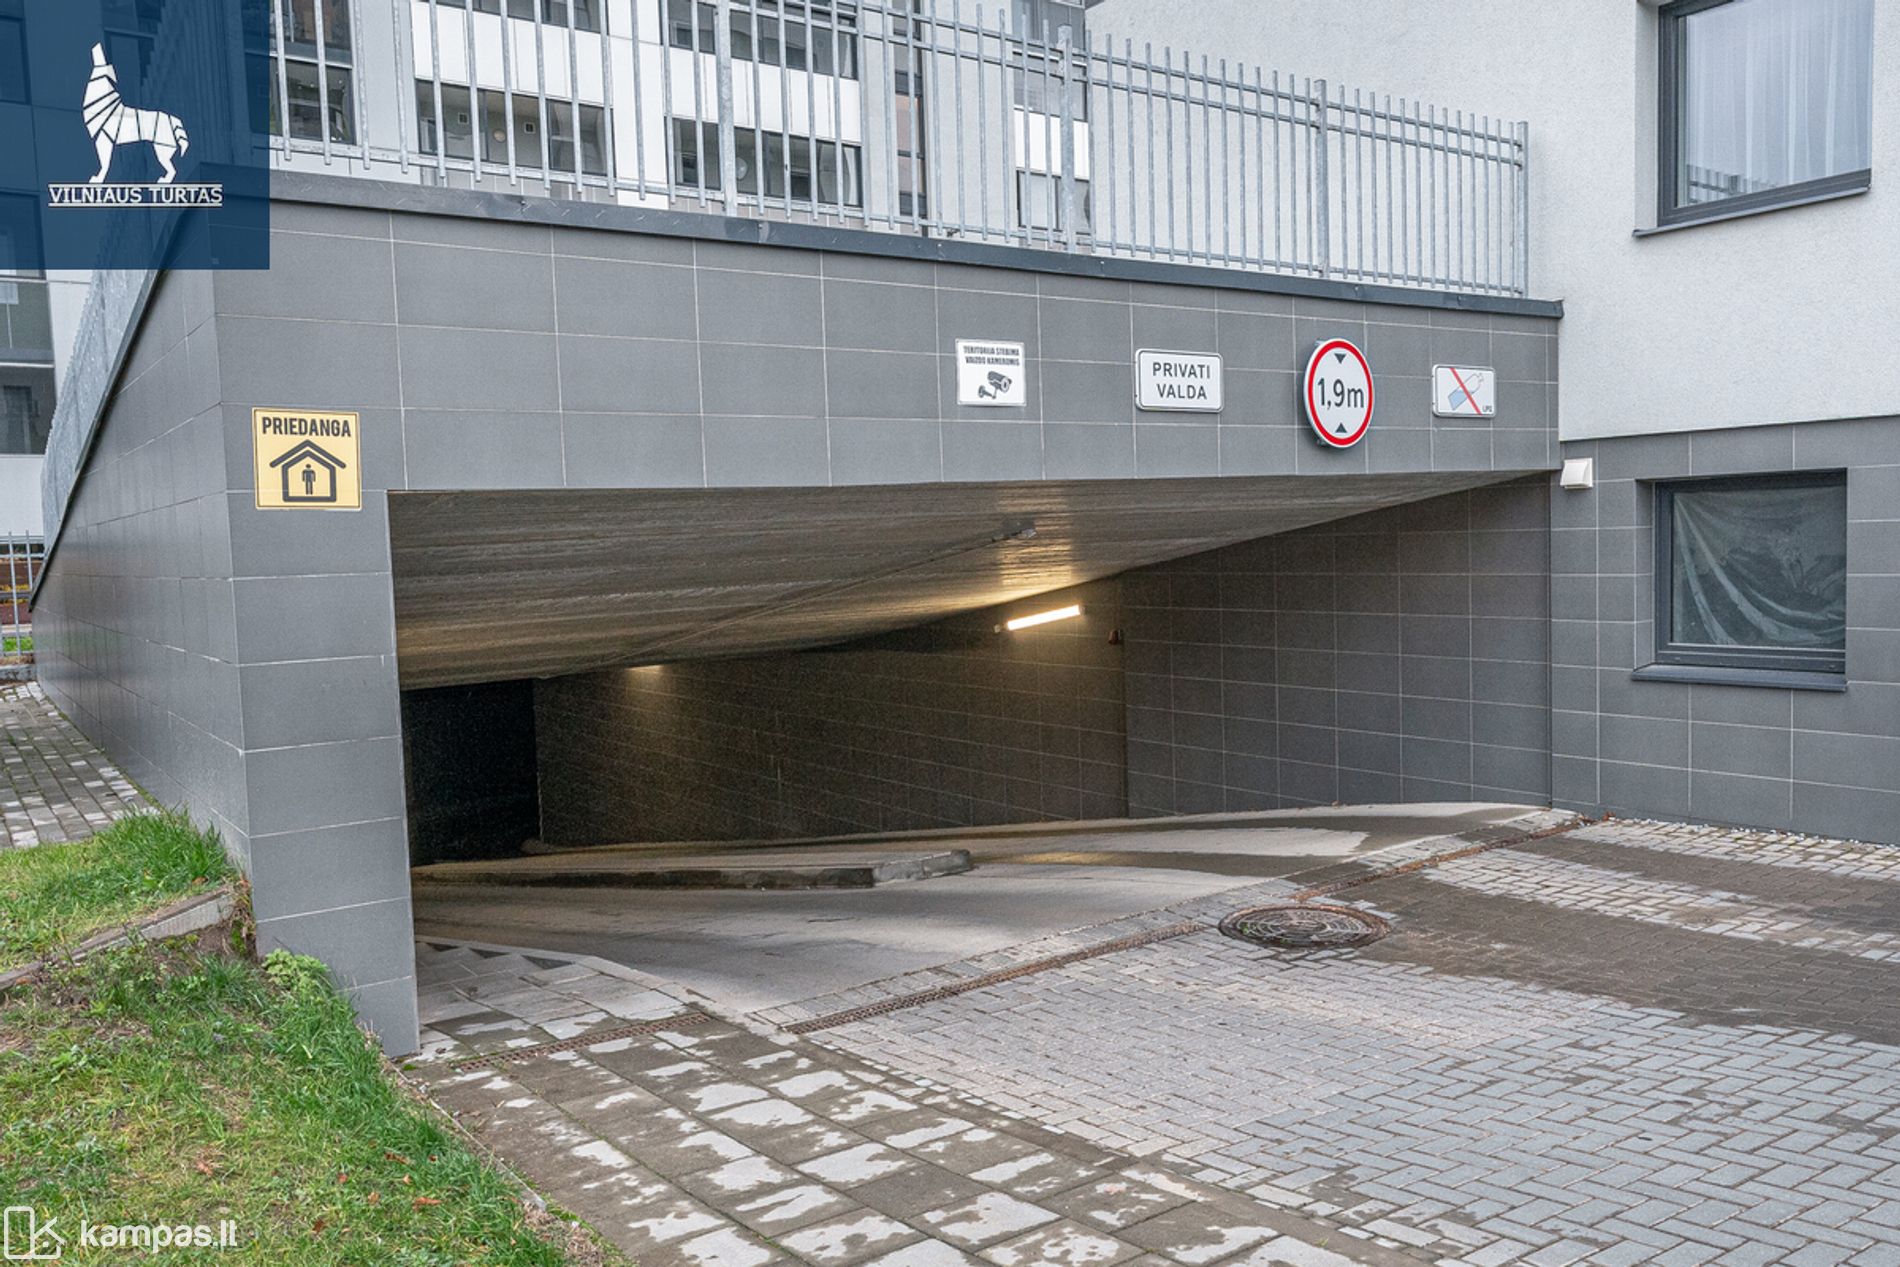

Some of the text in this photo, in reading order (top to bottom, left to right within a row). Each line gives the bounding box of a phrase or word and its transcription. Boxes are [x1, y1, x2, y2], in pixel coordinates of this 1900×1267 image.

[1152, 362, 1211, 379] PRIVATI
[1156, 383, 1207, 400] VALDA
[1317, 377, 1365, 410] 1,9m
[262, 416, 351, 437] PRIEDANGA
